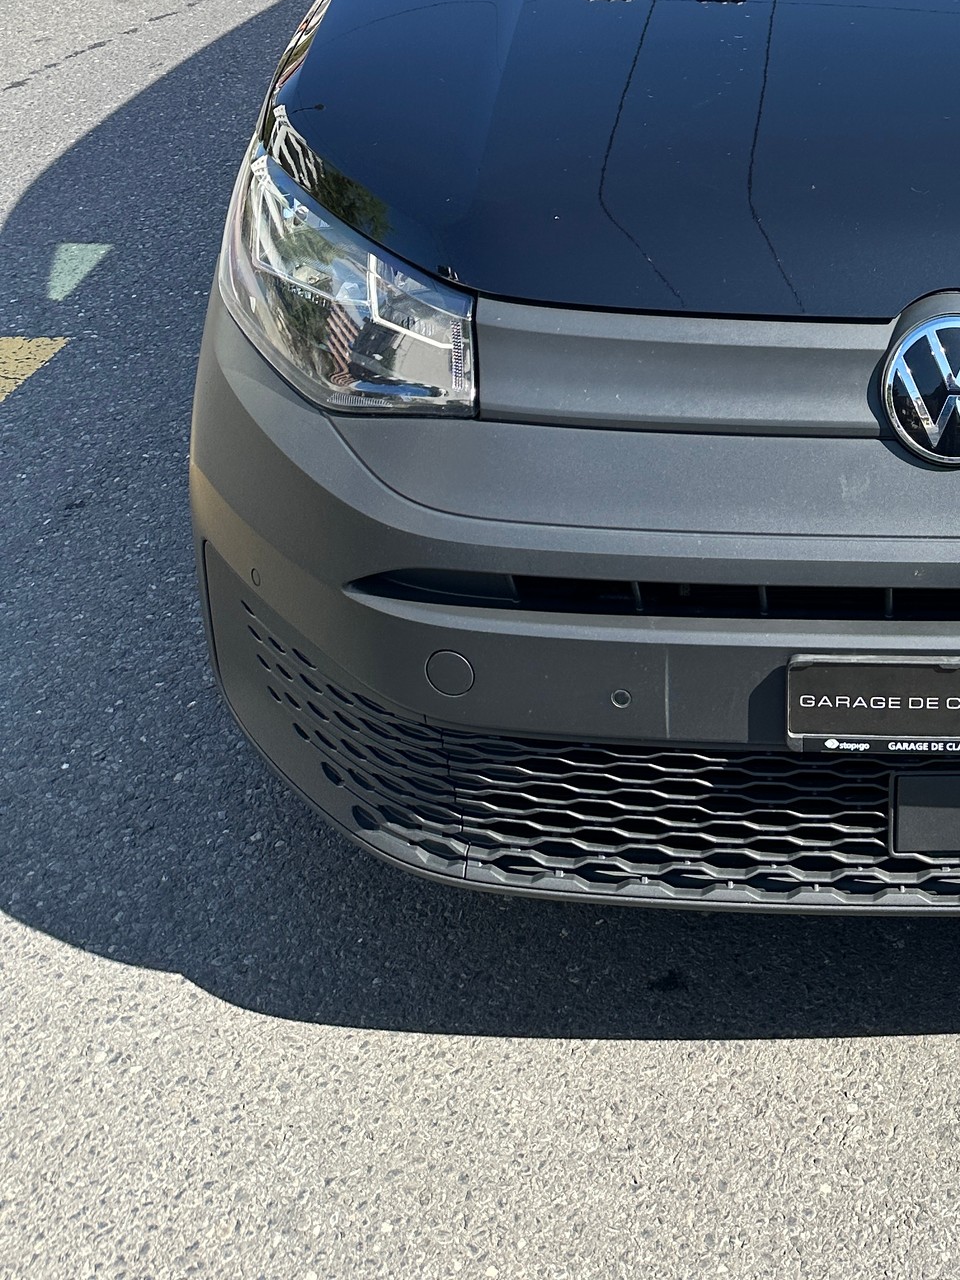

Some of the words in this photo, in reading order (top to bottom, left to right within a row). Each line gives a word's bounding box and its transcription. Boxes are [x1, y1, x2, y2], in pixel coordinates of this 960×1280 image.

[799, 695, 902, 709] GARAGE
[908, 697, 940, 710] DE
[888, 741, 929, 751] GARAGE
[931, 742, 944, 751] DE
